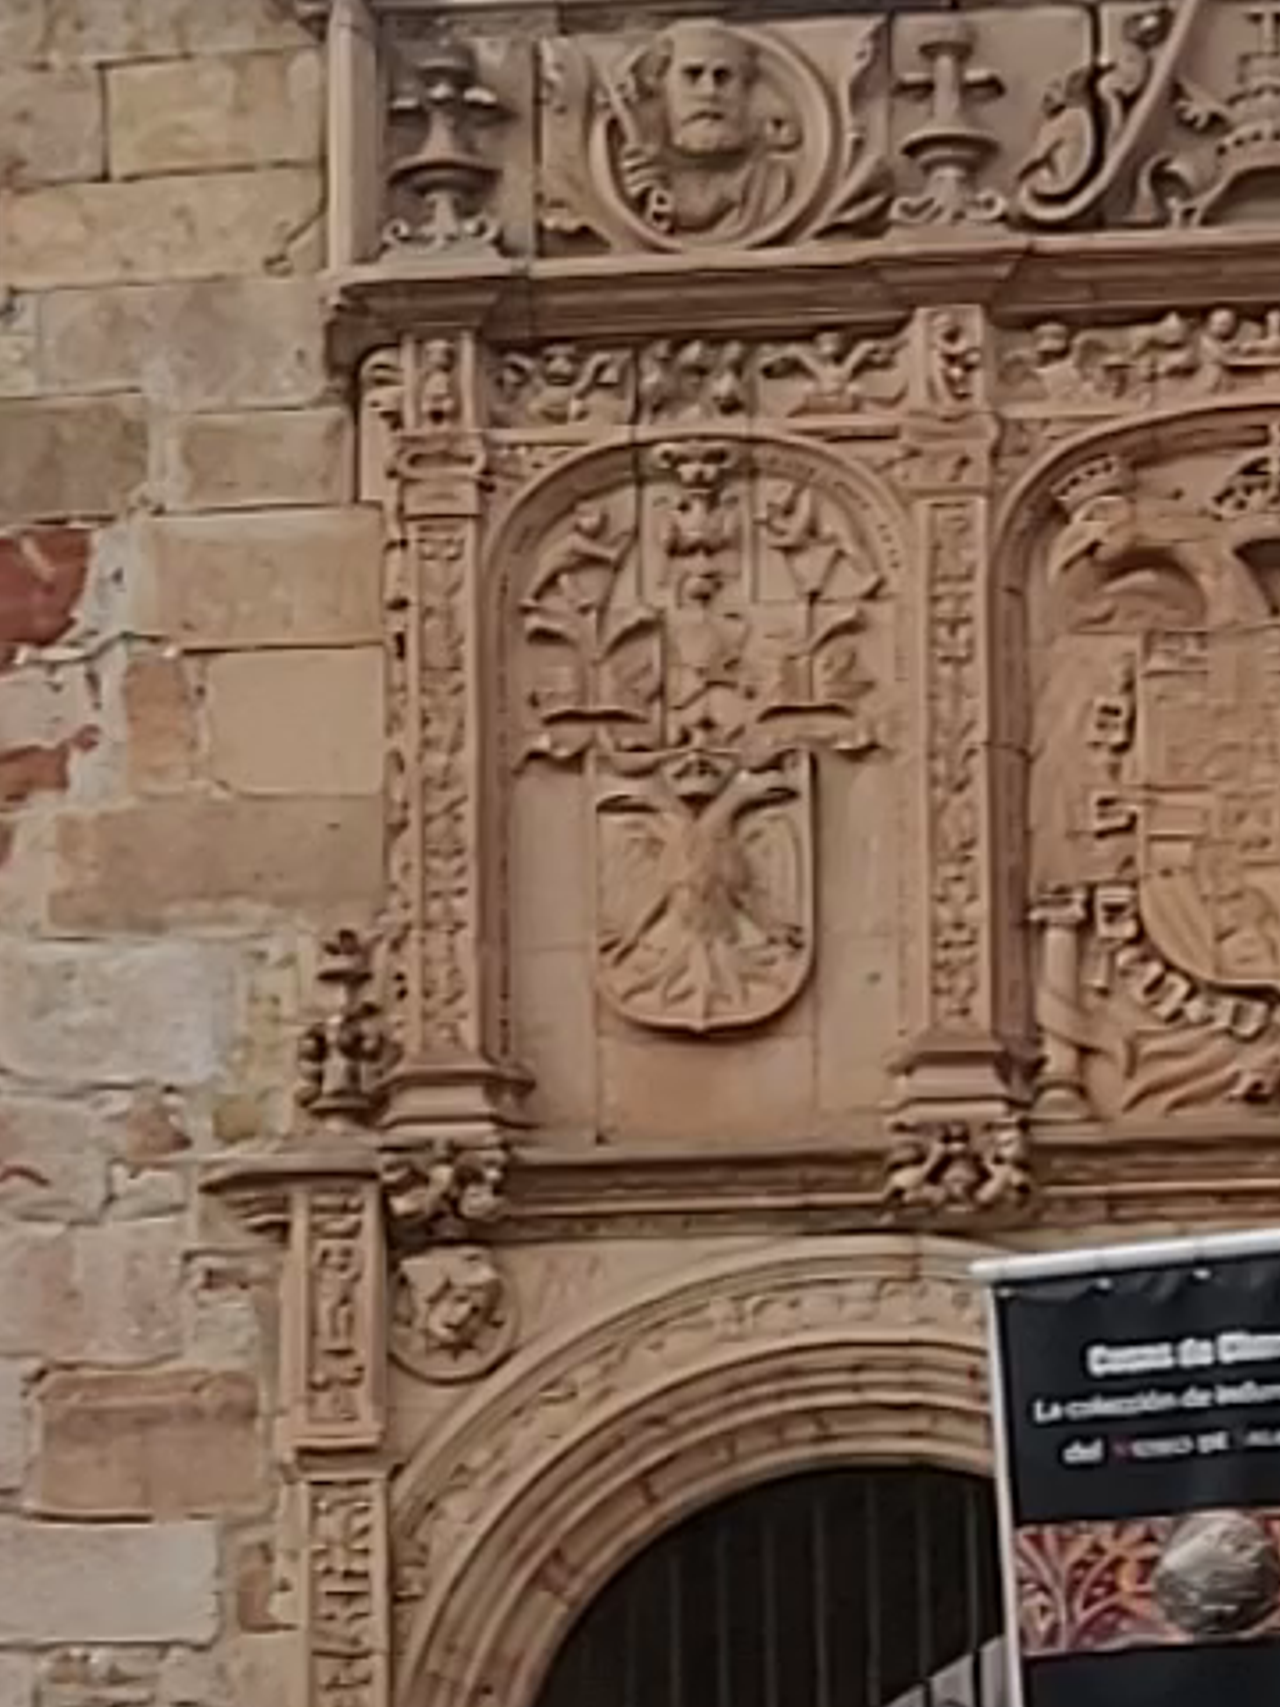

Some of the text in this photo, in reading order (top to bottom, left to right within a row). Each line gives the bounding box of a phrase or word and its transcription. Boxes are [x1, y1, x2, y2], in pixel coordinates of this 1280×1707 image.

[1033, 1398, 1063, 1423] La
[1181, 1385, 1213, 1408] de
[1063, 1438, 1103, 1464] del
